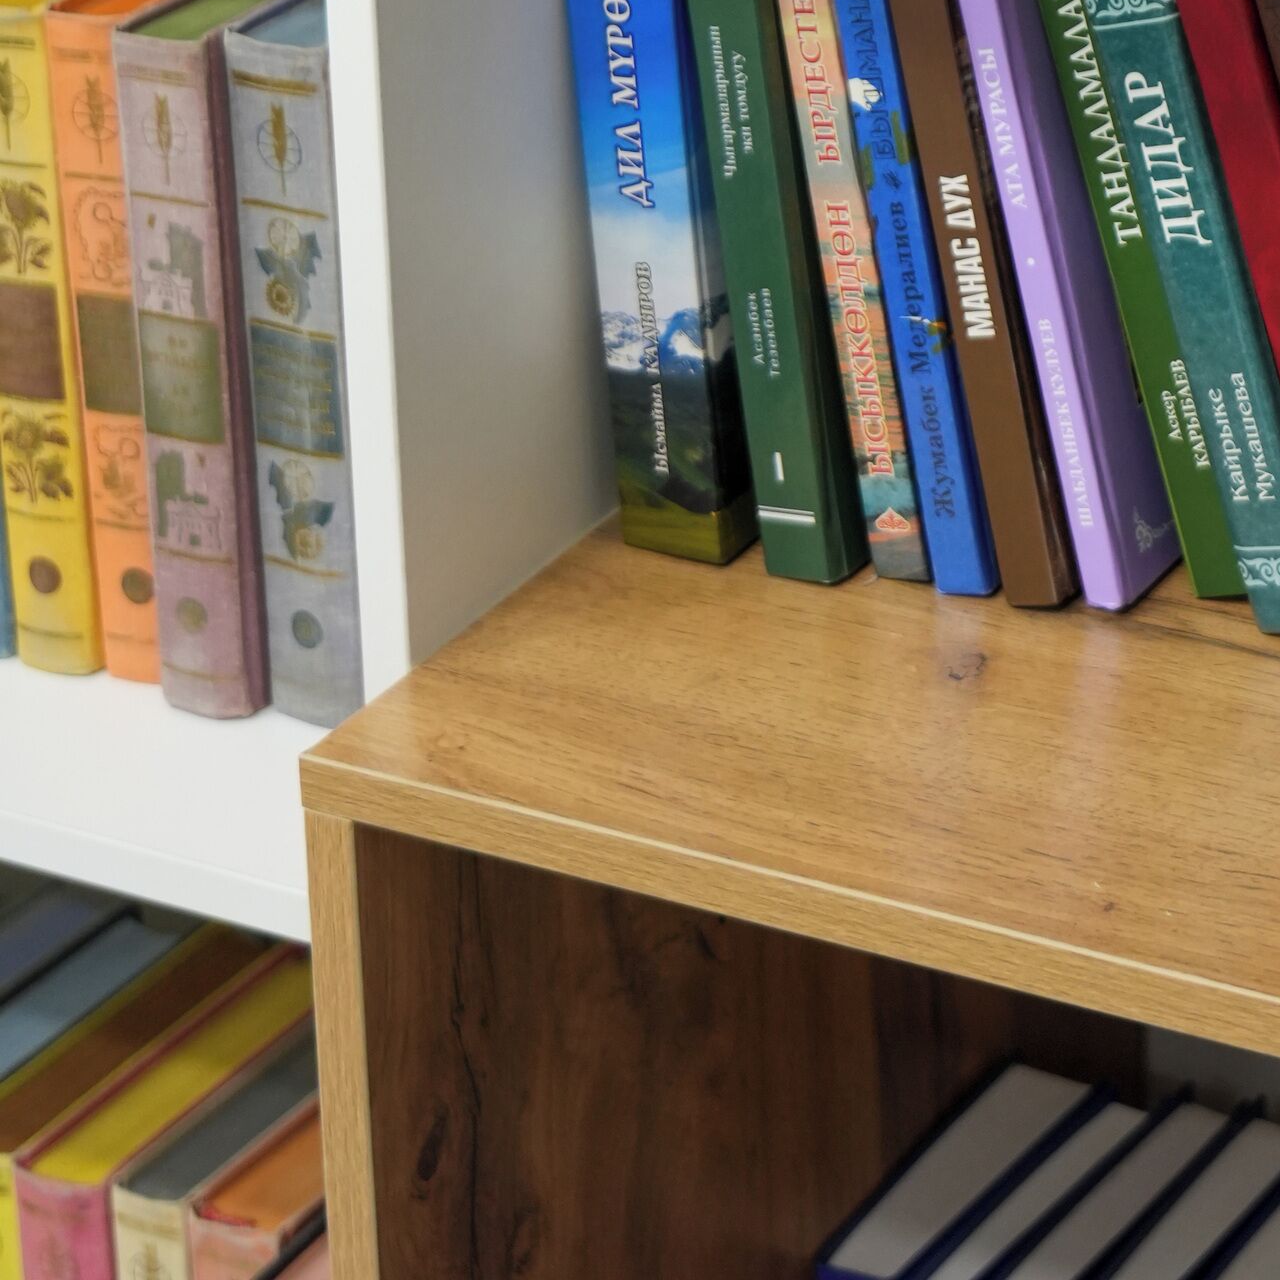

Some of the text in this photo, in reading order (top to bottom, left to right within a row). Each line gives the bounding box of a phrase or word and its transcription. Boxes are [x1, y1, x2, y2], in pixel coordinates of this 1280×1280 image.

[616, 119, 655, 208] ДИЛ
[977, 48, 1028, 208] АТА МУРАСЫ
[1124, 71, 1212, 245] ДИДАР
[938, 174, 997, 340] МАНАС ДУХ
[635, 261, 670, 478] Ысмайыл КАДЫРОВ
[746, 290, 766, 366] Асанбек
[760, 287, 781, 378] Тезекбаев
[824, 199, 895, 478] ЫСЫККӨЛДӨН
[922, 385, 956, 520] Жумабек
[1161, 389, 1185, 441] Аскер
[1170, 358, 1210, 468] КАРЫБАЕВ
[1209, 387, 1250, 503] Кайрыке
[1231, 372, 1276, 502] Мукашева
